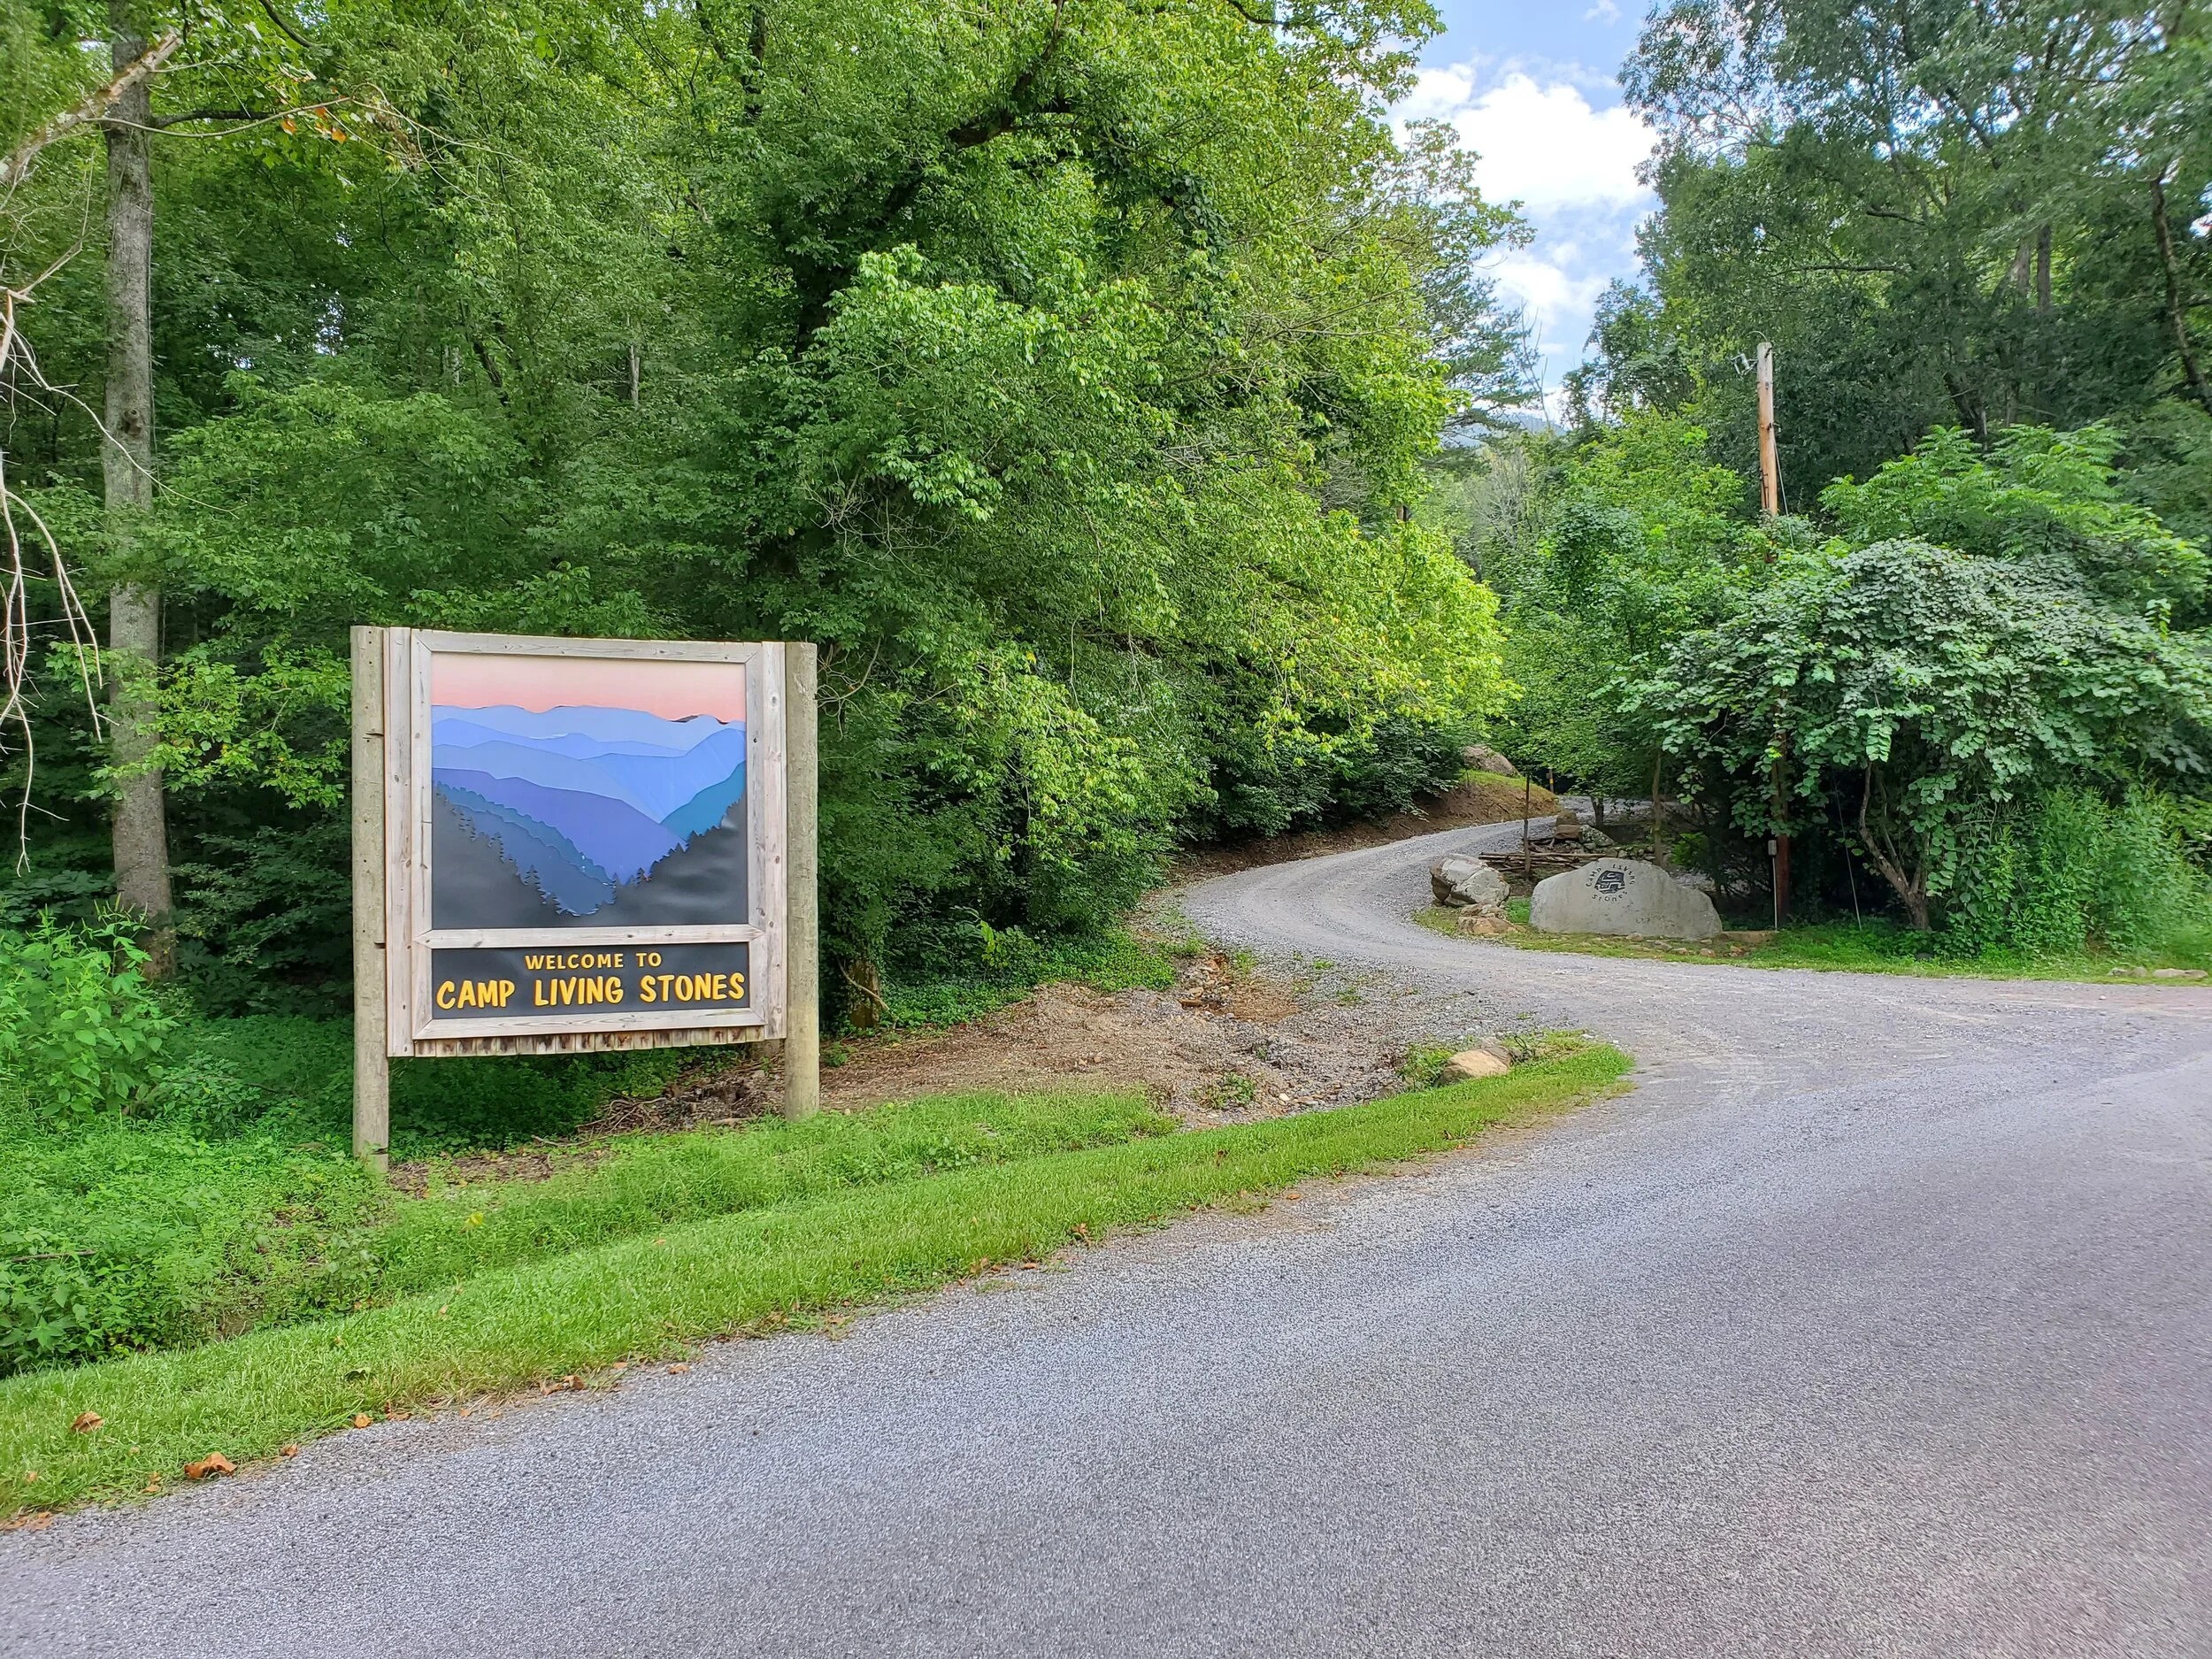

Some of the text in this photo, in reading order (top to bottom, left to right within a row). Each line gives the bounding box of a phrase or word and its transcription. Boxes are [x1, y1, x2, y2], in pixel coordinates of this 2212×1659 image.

[525, 952, 662, 970] WELCOME TO
[436, 972, 745, 1010] CAMP LIVING STONES
